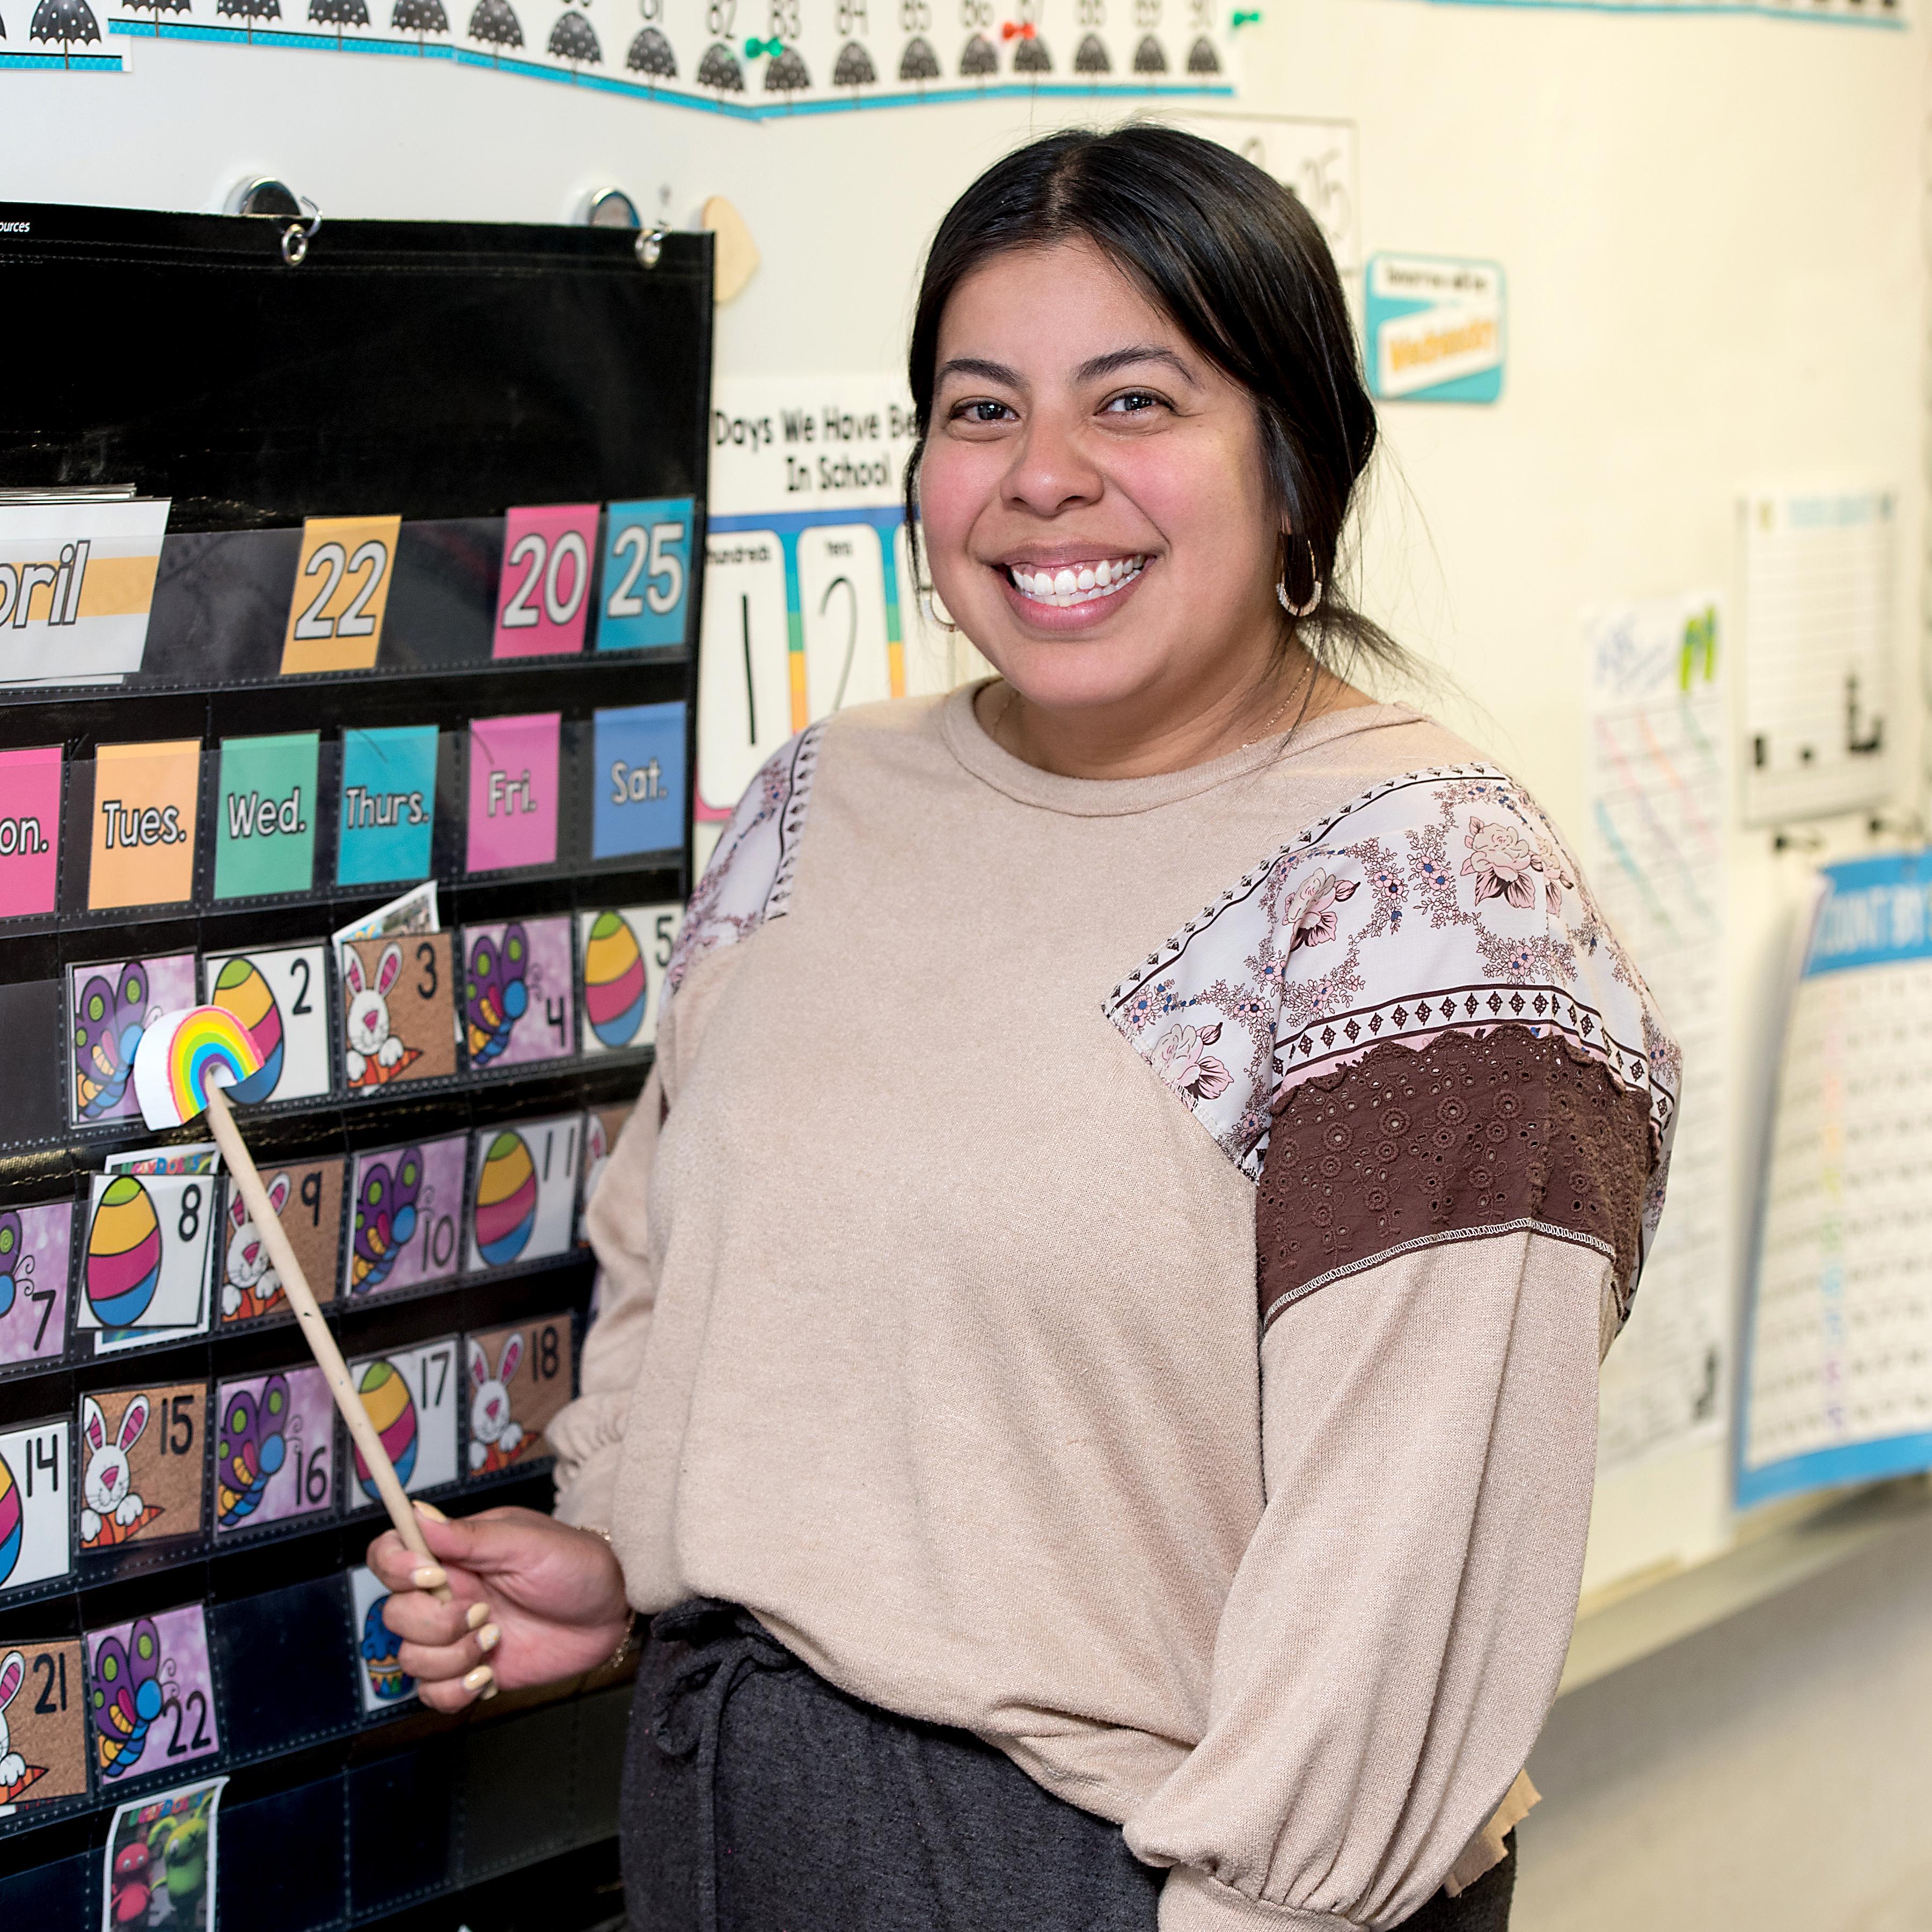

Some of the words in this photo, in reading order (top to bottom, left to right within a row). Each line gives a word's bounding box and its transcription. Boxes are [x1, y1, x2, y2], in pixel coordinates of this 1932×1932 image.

[715, 409, 773, 453] Days
[780, 407, 815, 442] We
[823, 406, 880, 440] Have
[889, 404, 917, 439] Be
[786, 456, 813, 492] In
[818, 452, 892, 491] School
[294, 540, 387, 640] 22
[502, 530, 588, 628] 20
[606, 522, 684, 619] 25
[103, 800, 186, 850] Tues.
[228, 787, 306, 839] Wed.
[345, 785, 430, 830] Thurs.
[488, 769, 537, 817] Fri.
[610, 758, 668, 804] Sat.
[290, 958, 312, 1015] 2
[416, 942, 437, 999] 3
[546, 996, 566, 1048] 4
[656, 916, 673, 967] 5
[32, 1289, 56, 1351] 7
[179, 1184, 201, 1241] 8
[301, 1170, 322, 1227] 9
[422, 1215, 455, 1272] 10
[544, 1126, 575, 1182] 11
[26, 1434, 58, 1497] 14
[161, 1395, 195, 1455] 15
[296, 1446, 326, 1505] 16
[421, 1351, 451, 1410] 17
[532, 1325, 560, 1382] 18
[33, 1652, 68, 1715] 21
[162, 1690, 211, 1758] 22
